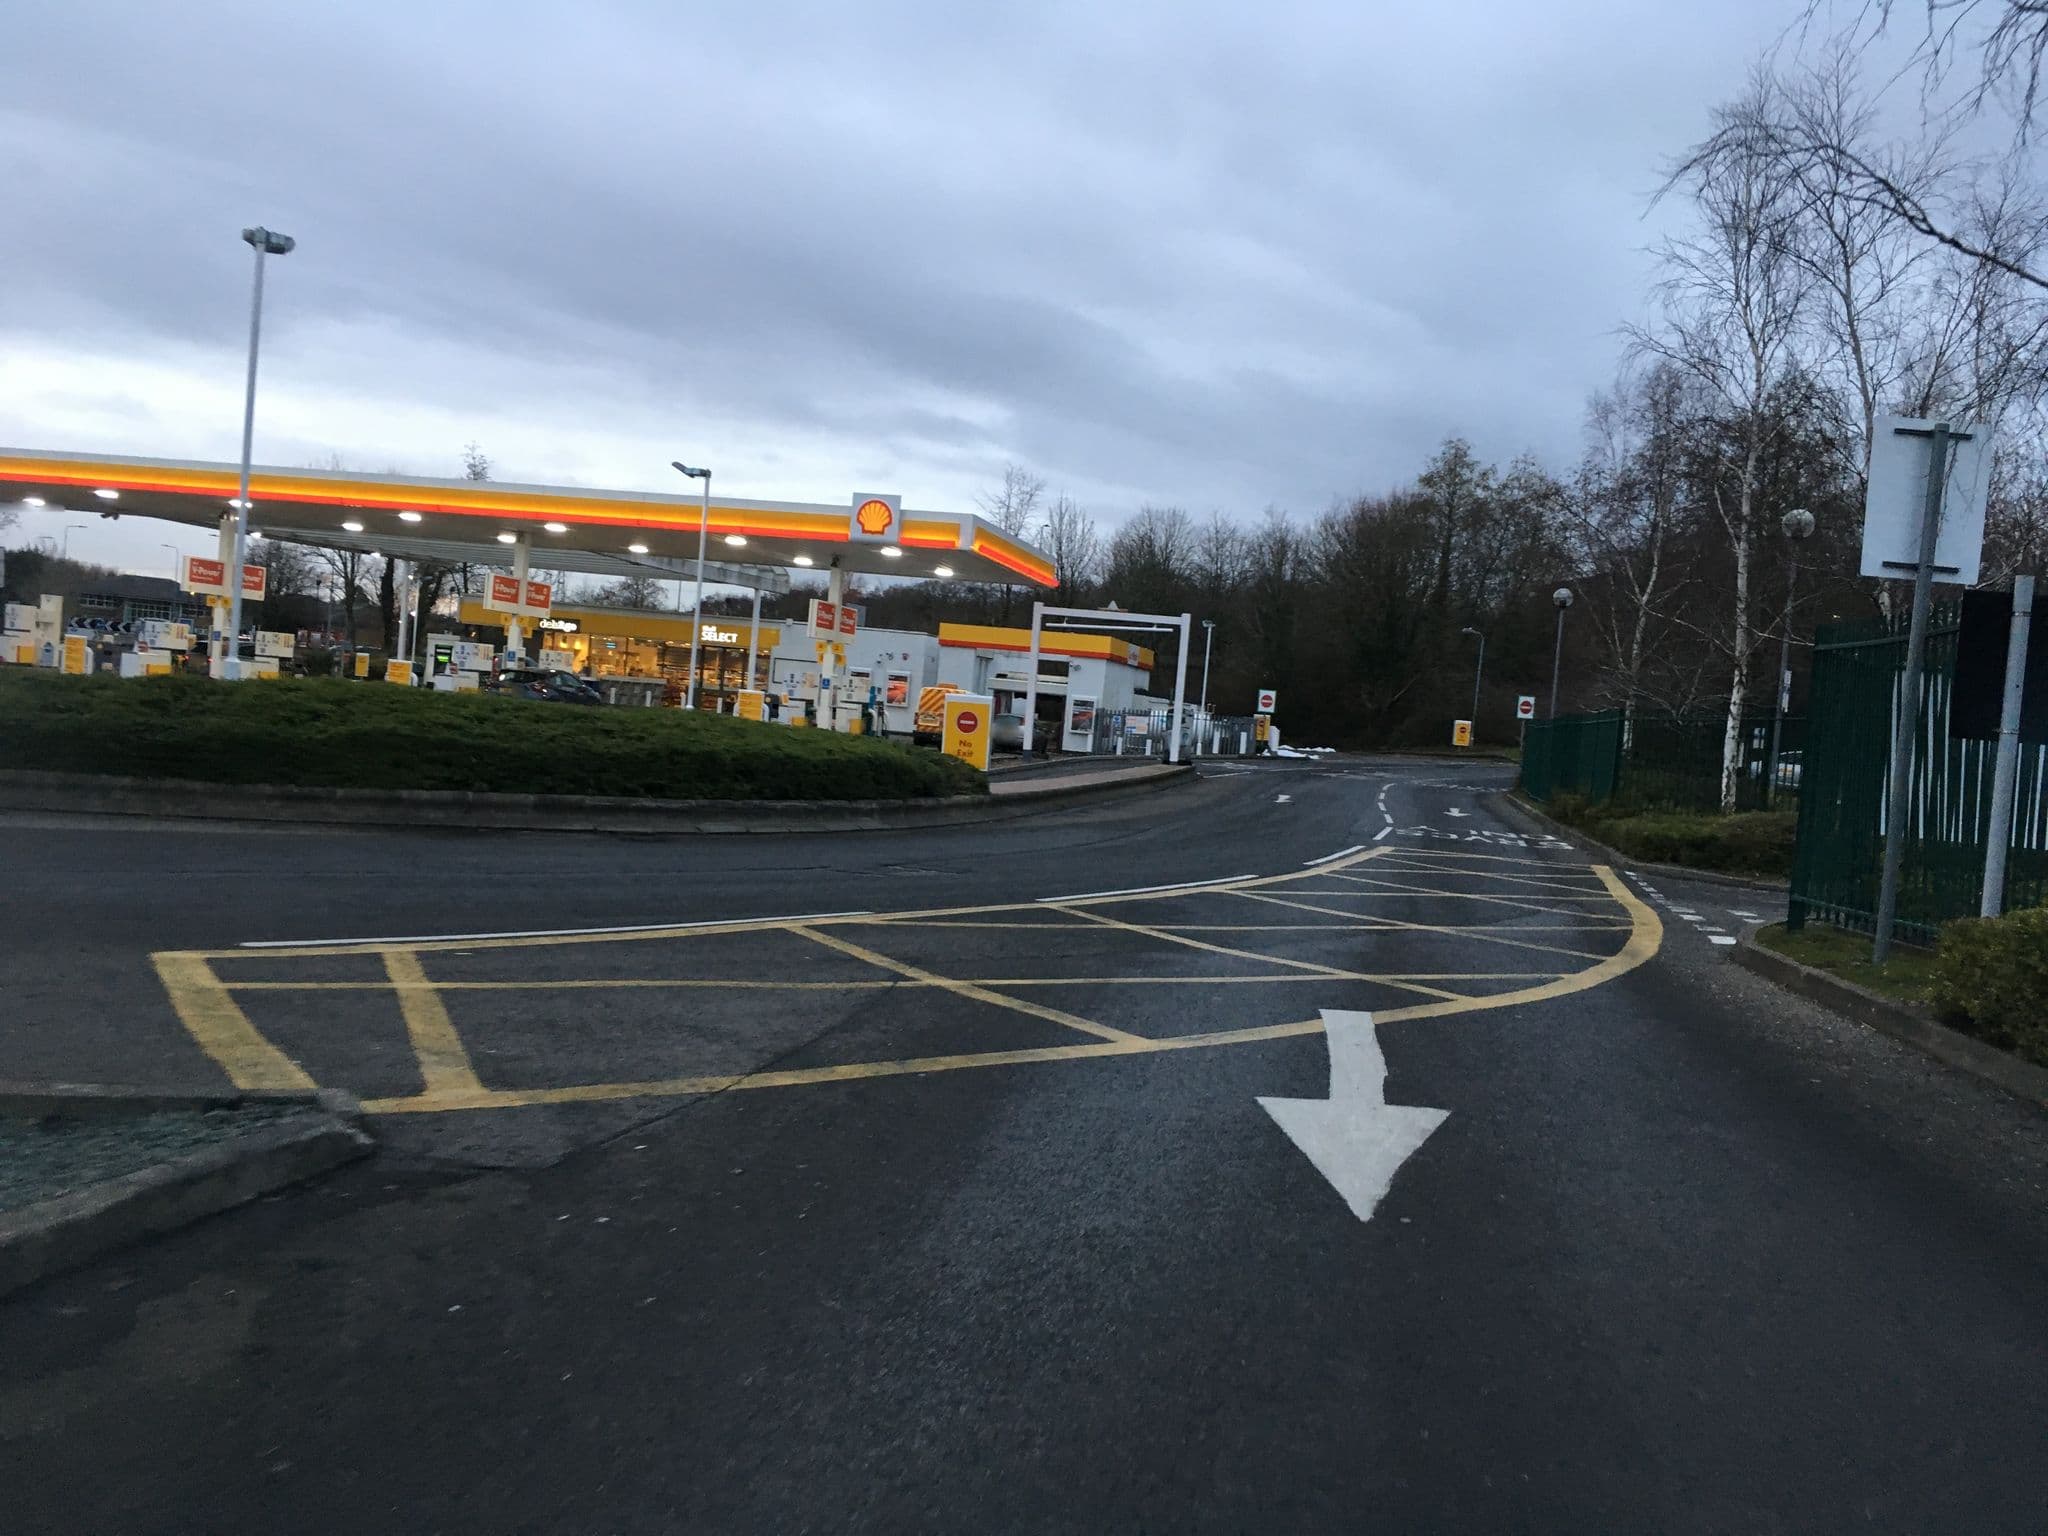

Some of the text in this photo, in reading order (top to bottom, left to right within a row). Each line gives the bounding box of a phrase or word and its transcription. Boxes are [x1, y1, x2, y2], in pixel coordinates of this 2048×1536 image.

[701, 631, 738, 643] SELECT
[959, 739, 973, 748] No
[957, 748, 974, 758] Exit
